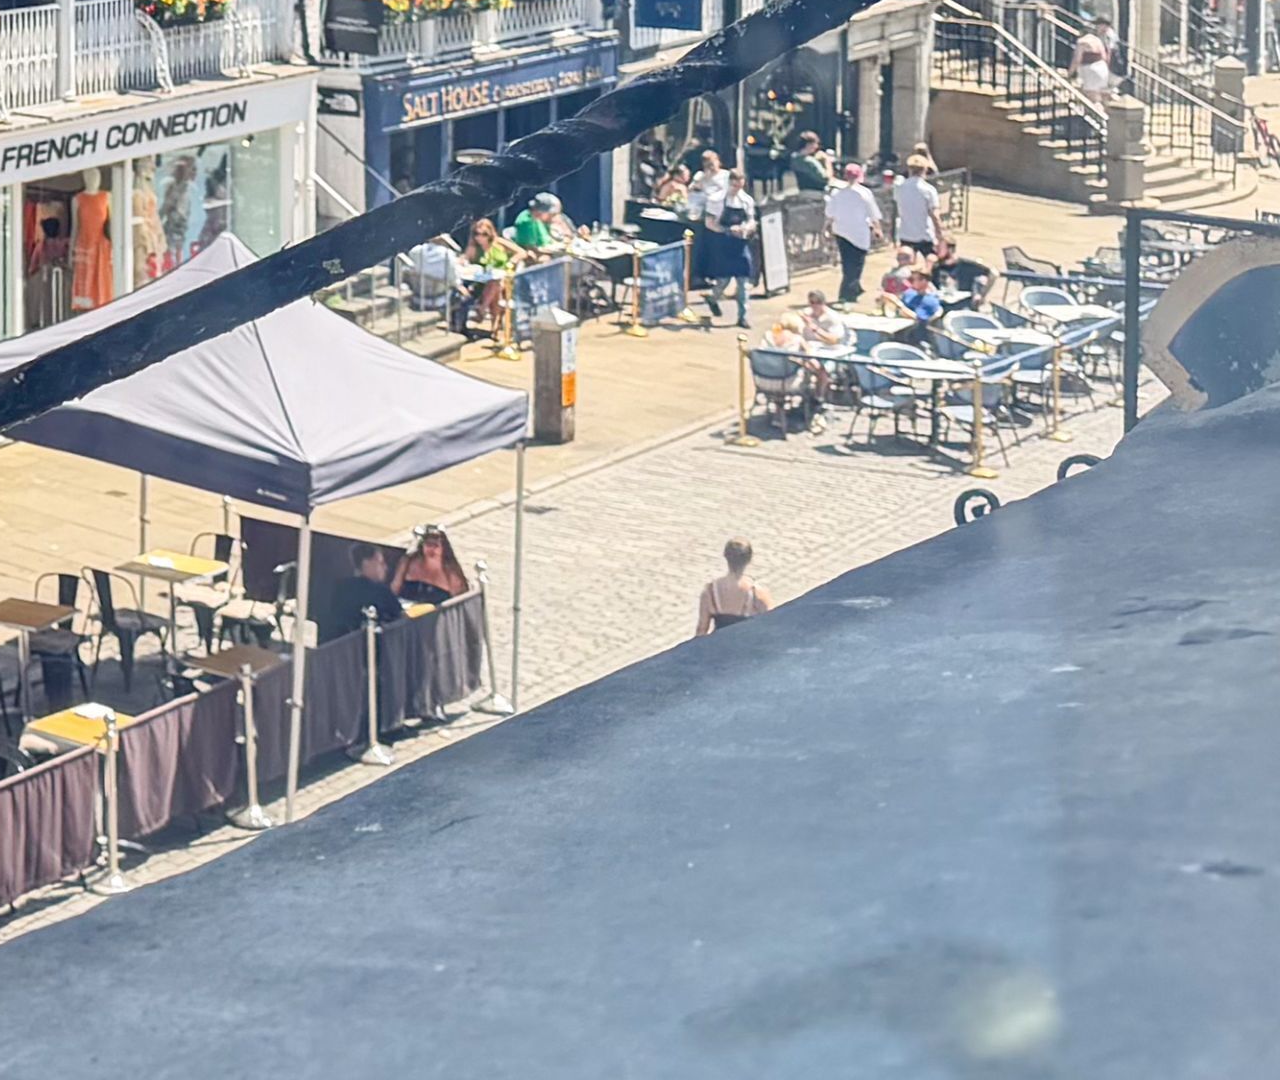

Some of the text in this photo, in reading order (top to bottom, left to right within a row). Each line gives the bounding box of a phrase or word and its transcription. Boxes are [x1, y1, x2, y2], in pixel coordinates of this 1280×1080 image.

[402, 92, 439, 120] SALT
[442, 80, 490, 111] HOUSE
[1, 100, 248, 172] FRENCH CONNECTION
